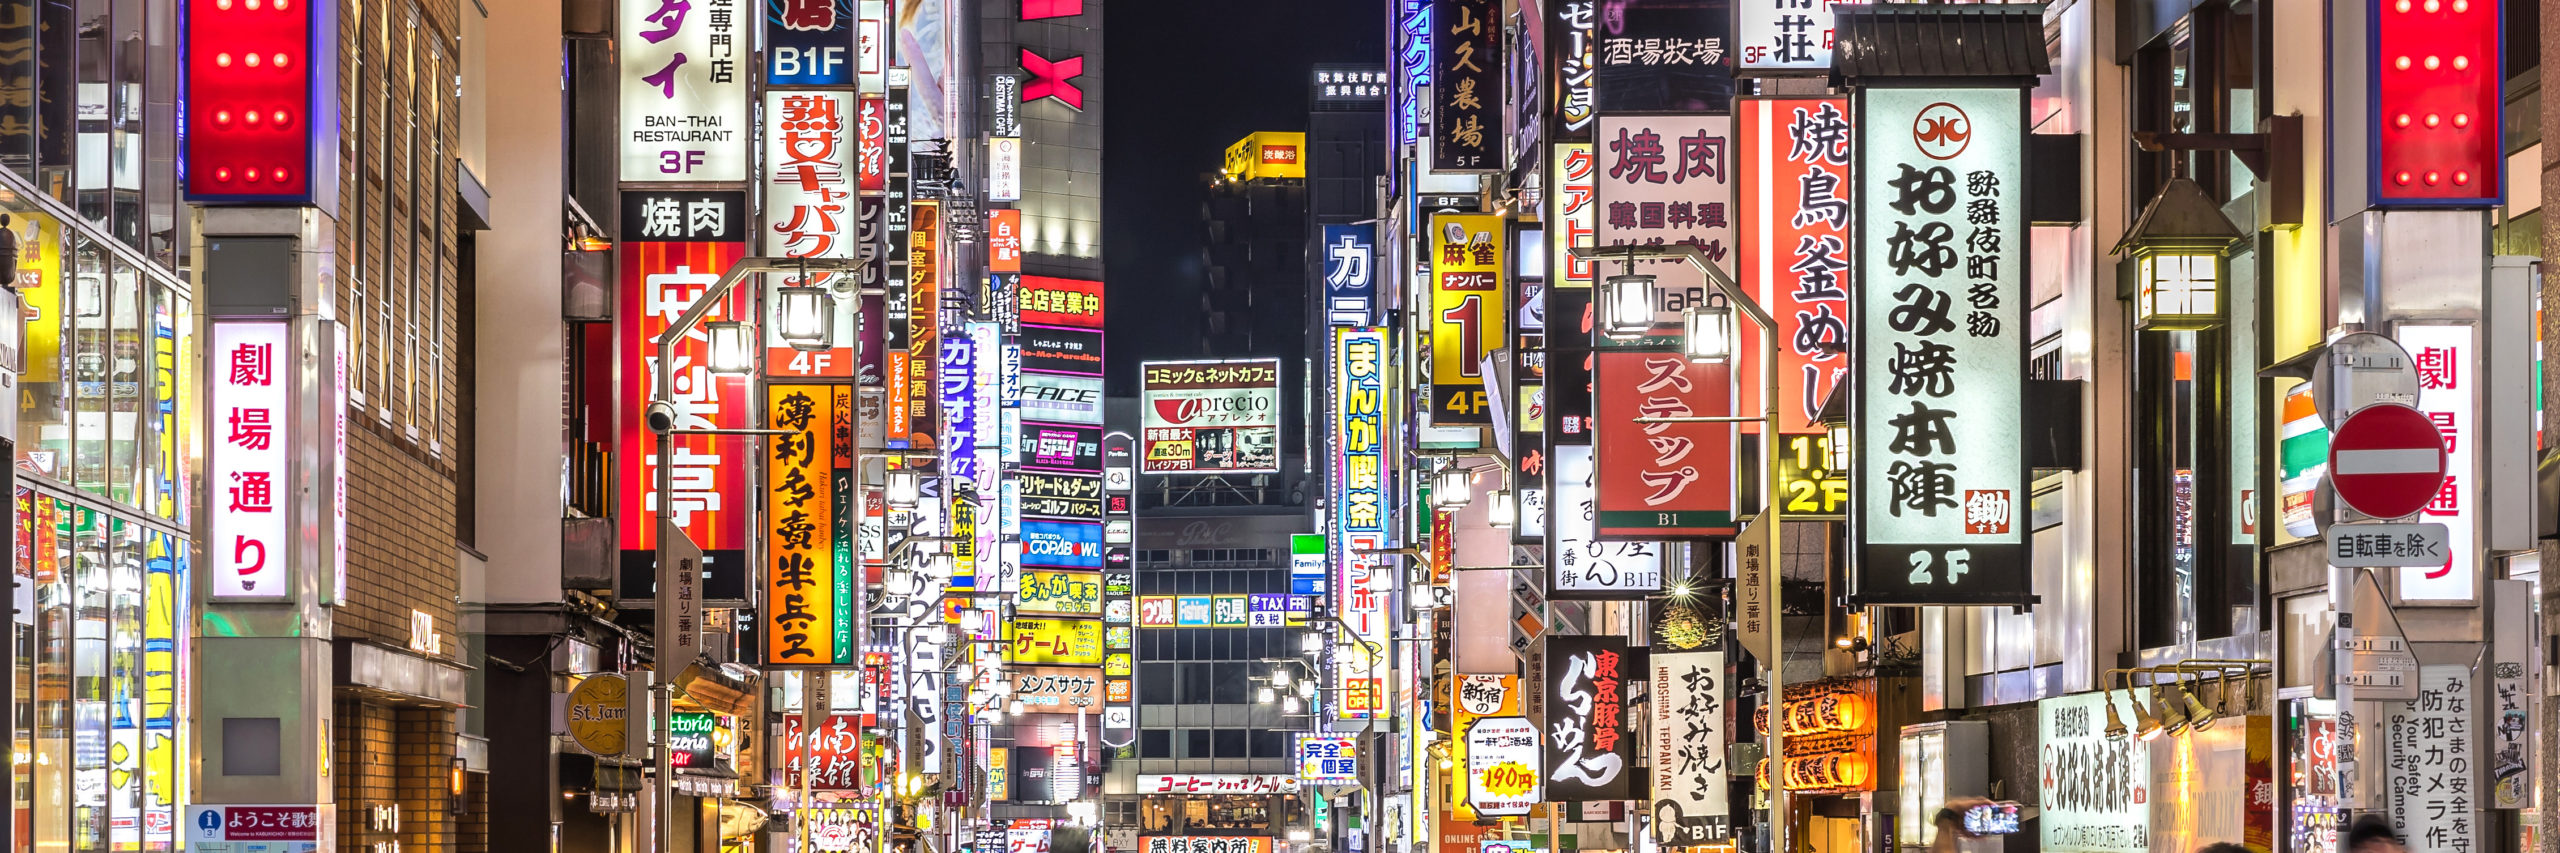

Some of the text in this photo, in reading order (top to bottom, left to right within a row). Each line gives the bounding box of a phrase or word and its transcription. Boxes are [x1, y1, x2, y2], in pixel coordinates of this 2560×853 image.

[774, 46, 846, 76] B1F
[1604, 37, 1725, 66] 酒場牧場
[1745, 46, 1767, 64] 3F
[1318, 72, 1387, 84] 歌舞伎町商
[1450, 0, 1484, 147] 山久農場
[1325, 85, 1389, 96] 振興組合
[644, 115, 723, 128] BAN-THAI
[633, 130, 733, 143] RESTAURANT
[659, 150, 706, 175] 3F
[1608, 127, 1727, 185] 焼肉
[641, 197, 727, 238] 焼肉
[1608, 200, 1728, 230] 韓国料理
[1443, 242, 1496, 266] 麻雀
[1788, 102, 1848, 420] 焼鳥釜めし
[1966, 170, 2001, 338] 歌舞伎町名物
[1445, 275, 1494, 288] ナンバー
[1019, 286, 1100, 316] 全店営業中
[1443, 294, 1482, 378] 1
[1886, 162, 1960, 518] お好み焼本陣
[788, 352, 832, 375] 4F
[1006, 346, 1019, 398] カラオケ
[1147, 367, 1275, 384] コミック&ネットカフェ
[944, 339, 972, 452] カラオケ
[1020, 386, 1100, 404] FACE
[1446, 391, 1487, 415] 4F
[1206, 412, 1267, 422] アプレシオ
[1001, 411, 1012, 457] SEGA
[1147, 427, 1193, 441] 新宿最大
[1348, 341, 1380, 530] まんが喫茶
[1636, 357, 1700, 507] ステップ
[228, 342, 273, 576] 劇場通り
[1001, 483, 1012, 527] SEGA
[1041, 500, 1069, 515] ゴルフ
[1787, 480, 1848, 512] 2F
[1657, 513, 1679, 526] B1
[2337, 533, 2439, 558] 自転車を除く
[1560, 537, 1578, 589] 一番街
[1907, 548, 1971, 585] 2F
[1020, 573, 1099, 601] まんが喫茶
[1623, 571, 1659, 588] B1F
[1745, 544, 1761, 633] 劇場通り一番街
[679, 556, 693, 647] 劇場通り一番街
[1180, 599, 1211, 626] Fishing
[1215, 599, 1246, 623] 釣具
[1260, 598, 1285, 611] TAX
[1254, 613, 1280, 626] 免税
[1016, 632, 1069, 656] ゲーム
[1107, 661, 1130, 669] ゲーム
[1020, 675, 1096, 694] メンズサウナ
[1462, 682, 1502, 704] 新宿
[1531, 652, 1542, 714] 劇場通り一番街
[1592, 649, 1620, 752] 東京豚骨
[1658, 665, 1672, 791] HIROSHIMA TEPPANYAKI
[1675, 664, 1722, 803] お好み焼き
[1306, 743, 1340, 758] 完全
[2391, 714, 2406, 771] Security
[1321, 759, 1355, 774] 個室
[2406, 717, 2422, 797] Your Safety
[2421, 689, 2448, 848] 防犯カメラ作
[2446, 677, 2470, 853] みなさまの安全を守
[1157, 776, 1213, 792] コーヒー
[1252, 775, 1280, 793] クール
[1485, 766, 1534, 789] 190円
[2394, 775, 2407, 830] Camera
[1444, 834, 1476, 844] ONLINE
[1691, 824, 1727, 841] B1F
